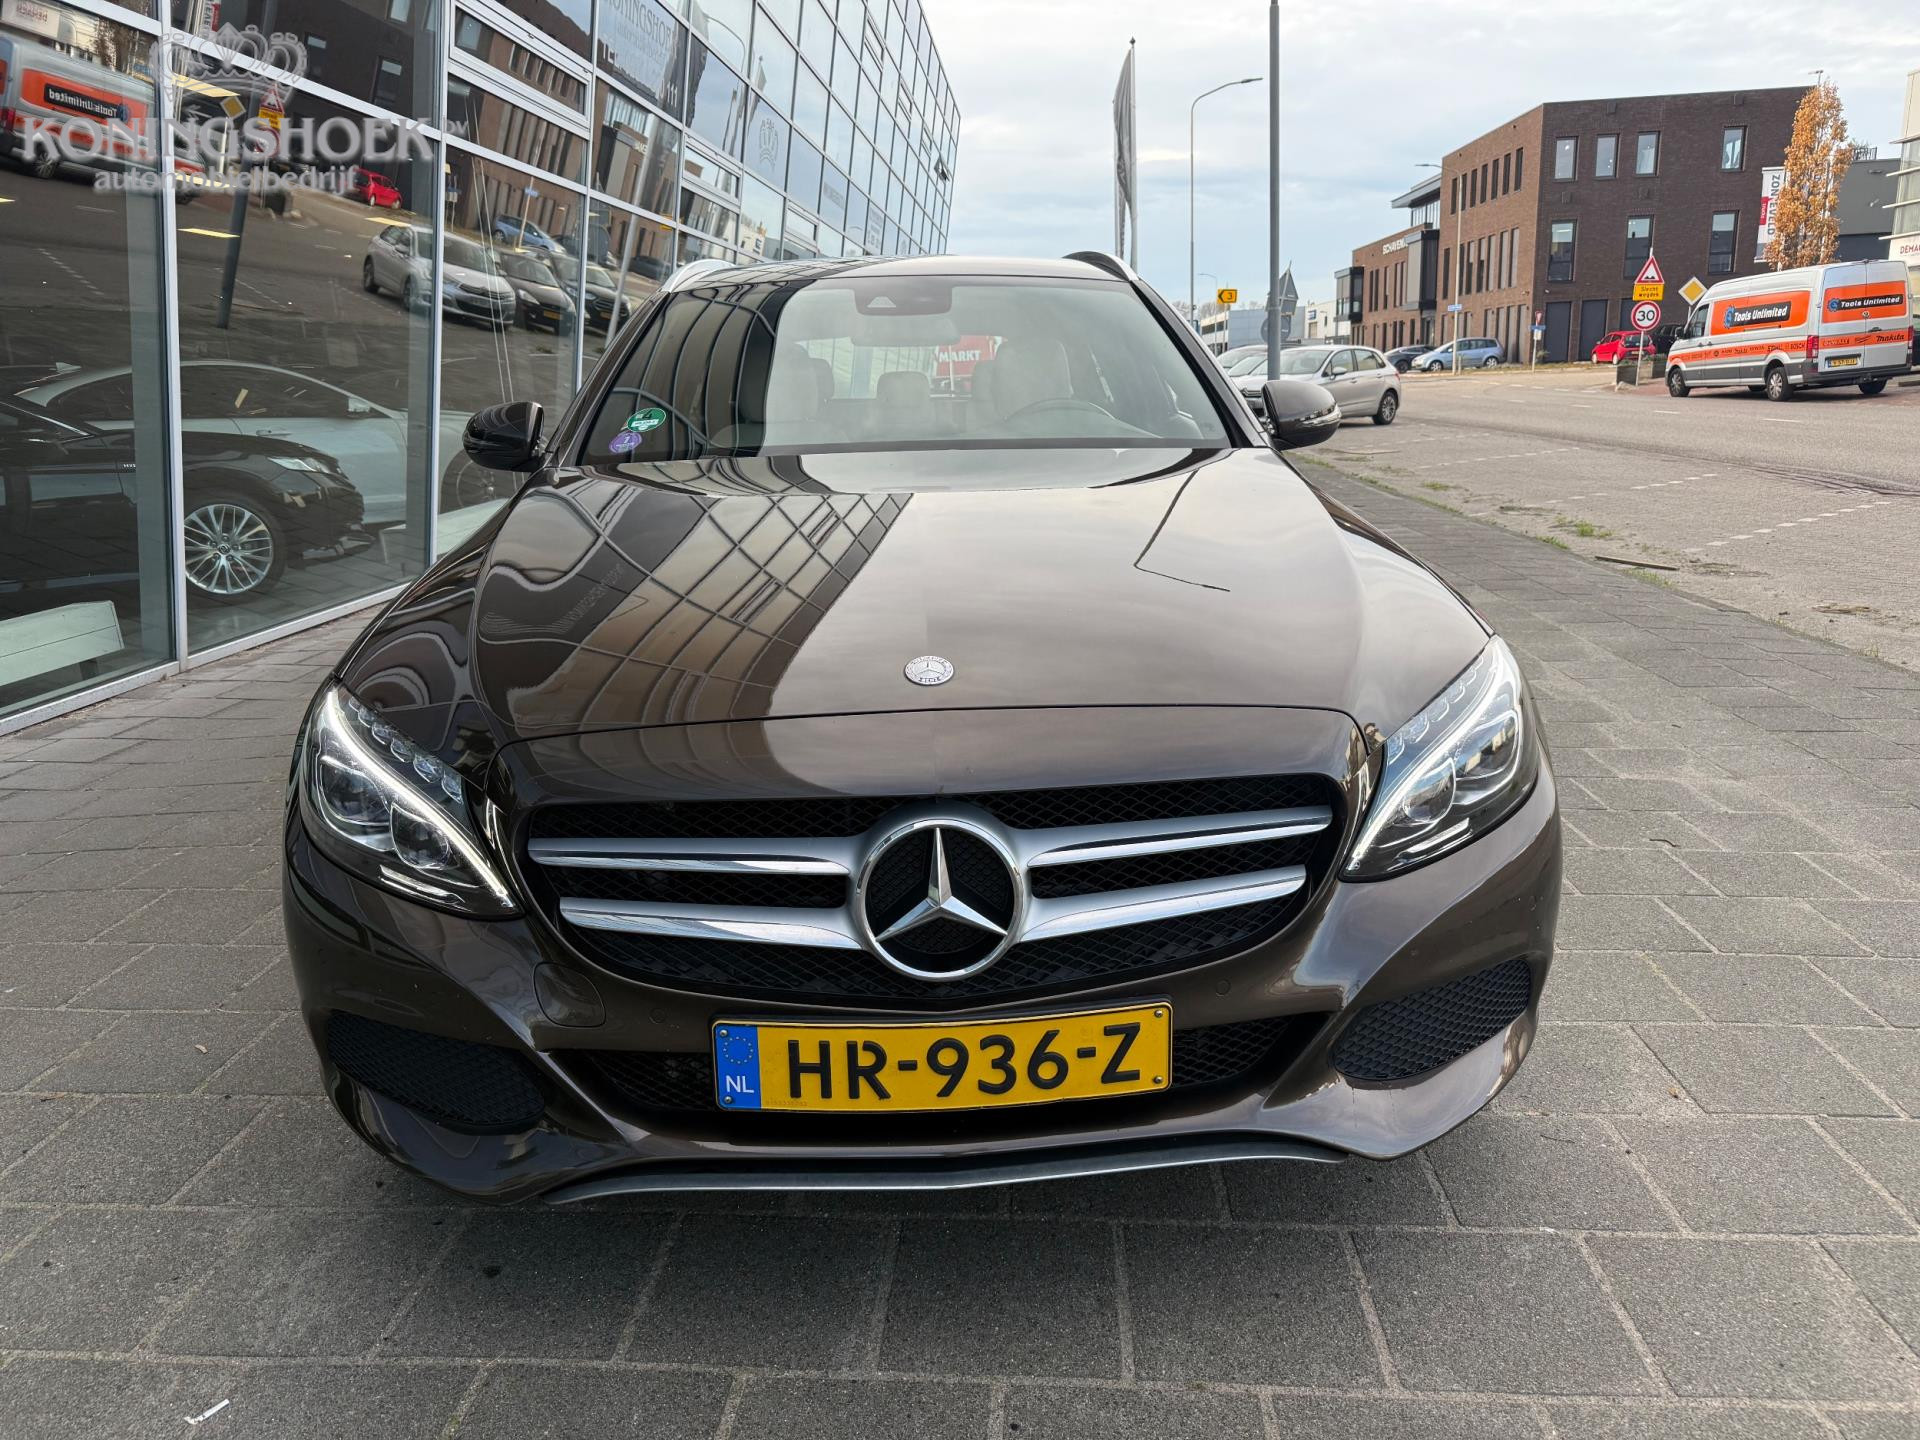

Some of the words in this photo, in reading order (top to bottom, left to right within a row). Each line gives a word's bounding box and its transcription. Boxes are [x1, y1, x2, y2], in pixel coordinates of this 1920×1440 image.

[1766, 174, 1781, 236] ZONEVELD
[1841, 300, 1862, 308] Tools
[1863, 296, 1900, 306] Unlimited
[1636, 310, 1655, 321] 30
[1734, 311, 1752, 322] Tools
[1752, 305, 1788, 320] Unlimited
[939, 350, 980, 362] MARKT
[787, 1022, 1141, 1099] HR-936-Z
[726, 1075, 754, 1093] NL
